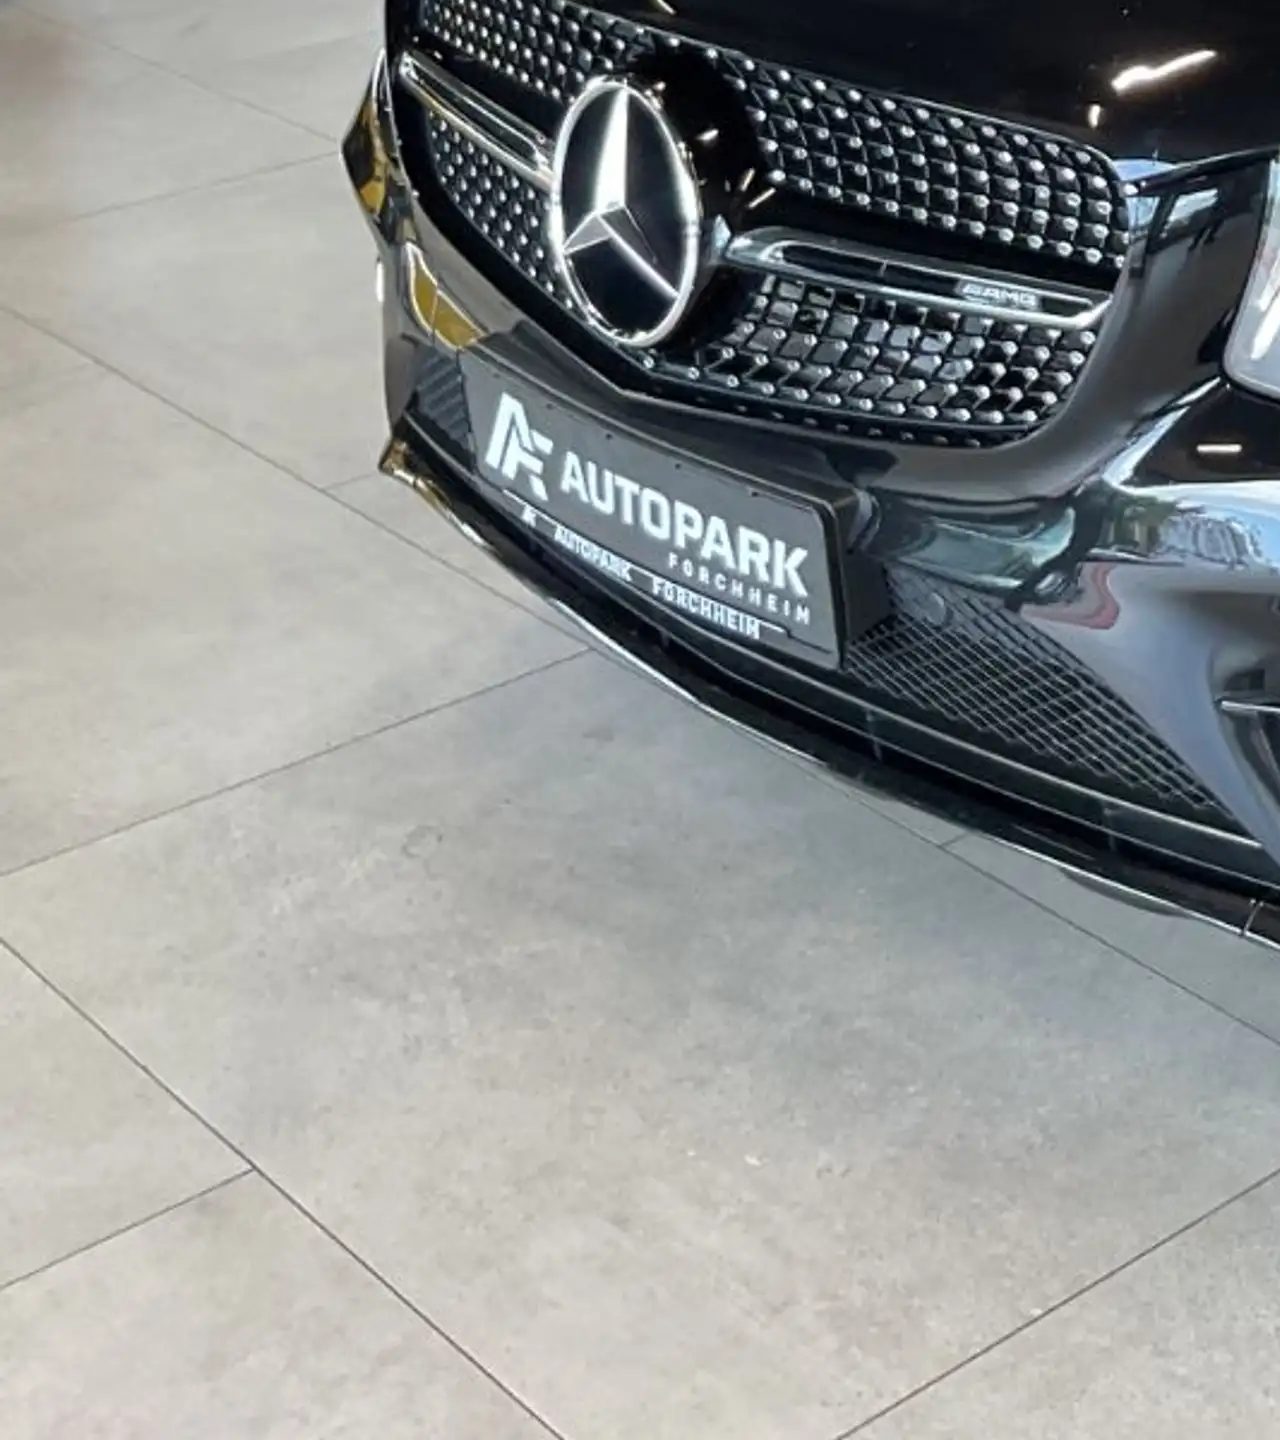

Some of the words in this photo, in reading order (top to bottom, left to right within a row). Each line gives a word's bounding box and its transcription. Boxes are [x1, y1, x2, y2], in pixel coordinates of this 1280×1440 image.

[561, 451, 808, 597] AUTOPARK
[652, 576, 760, 640] FORCHHEIM
[668, 552, 810, 624] FORCHHEIM
